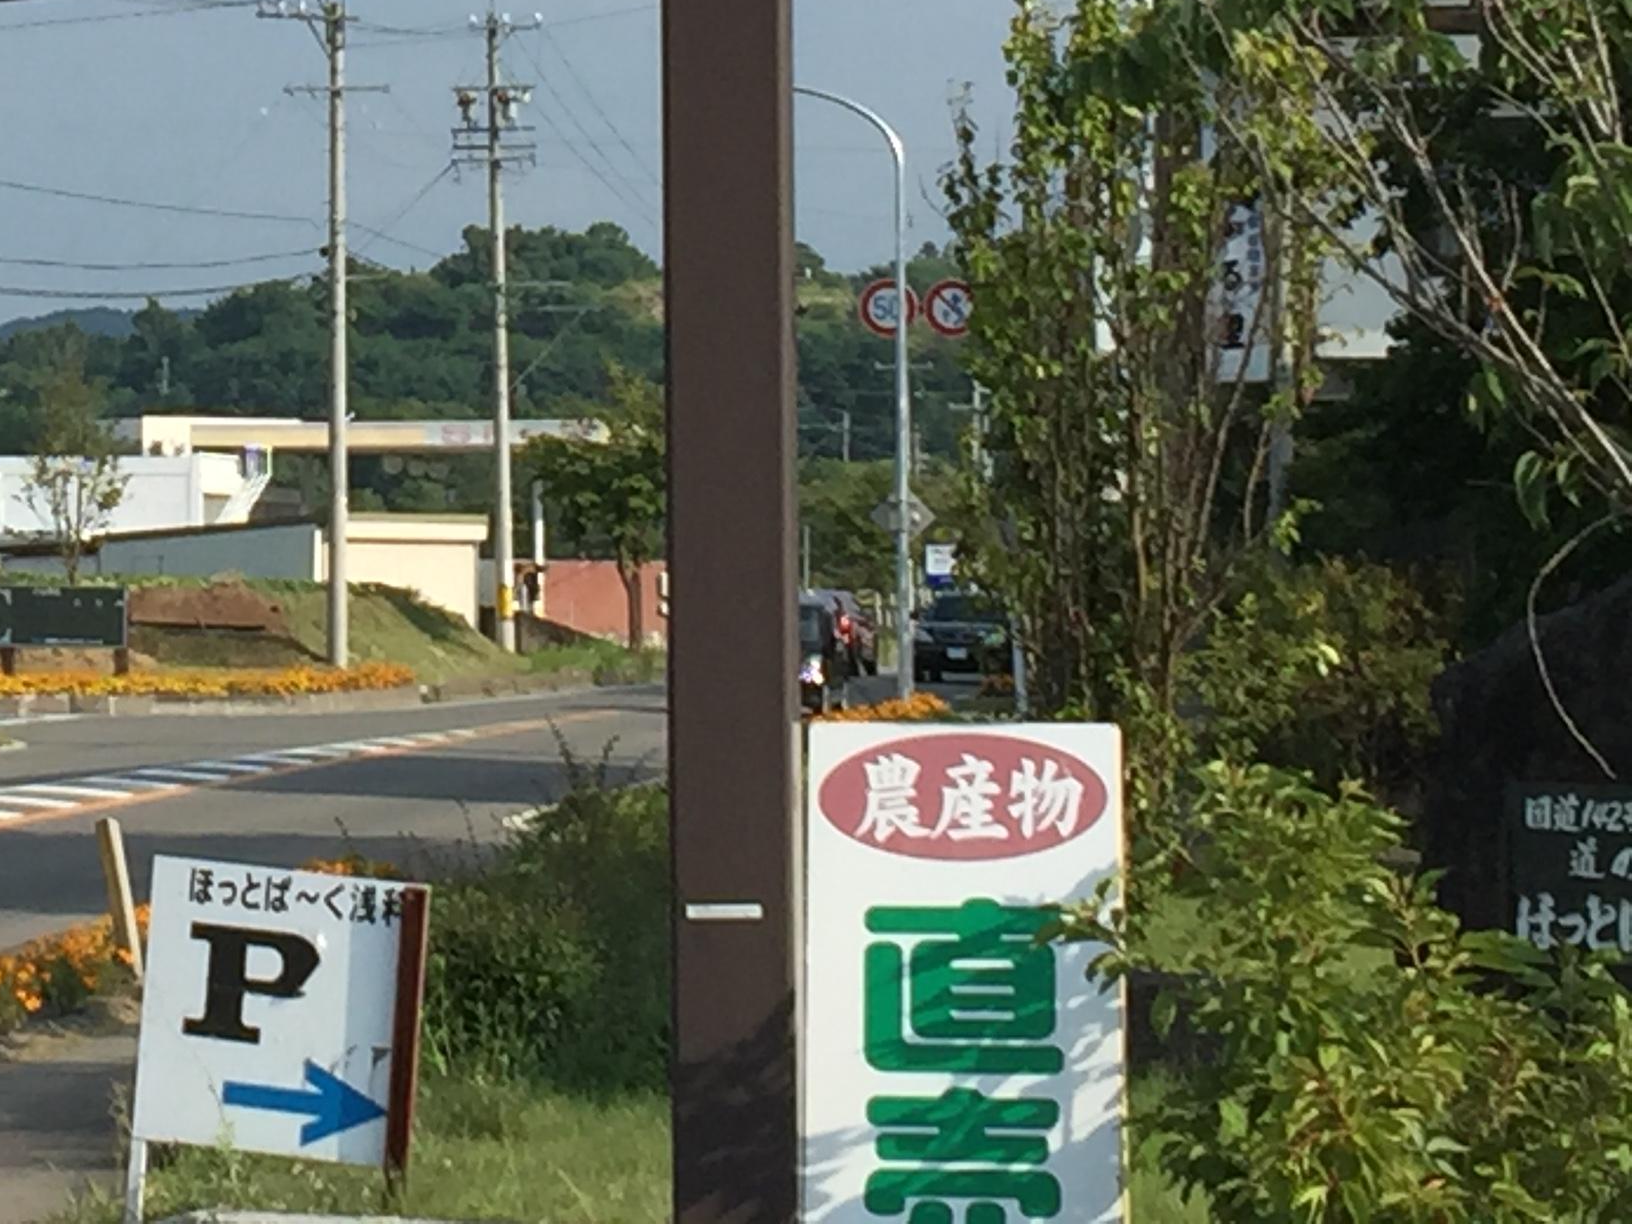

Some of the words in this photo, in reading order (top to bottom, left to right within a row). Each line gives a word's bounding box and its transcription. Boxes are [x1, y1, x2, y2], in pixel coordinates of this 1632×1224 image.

[854, 752, 1085, 843] 農産物
[182, 920, 321, 1045] P
